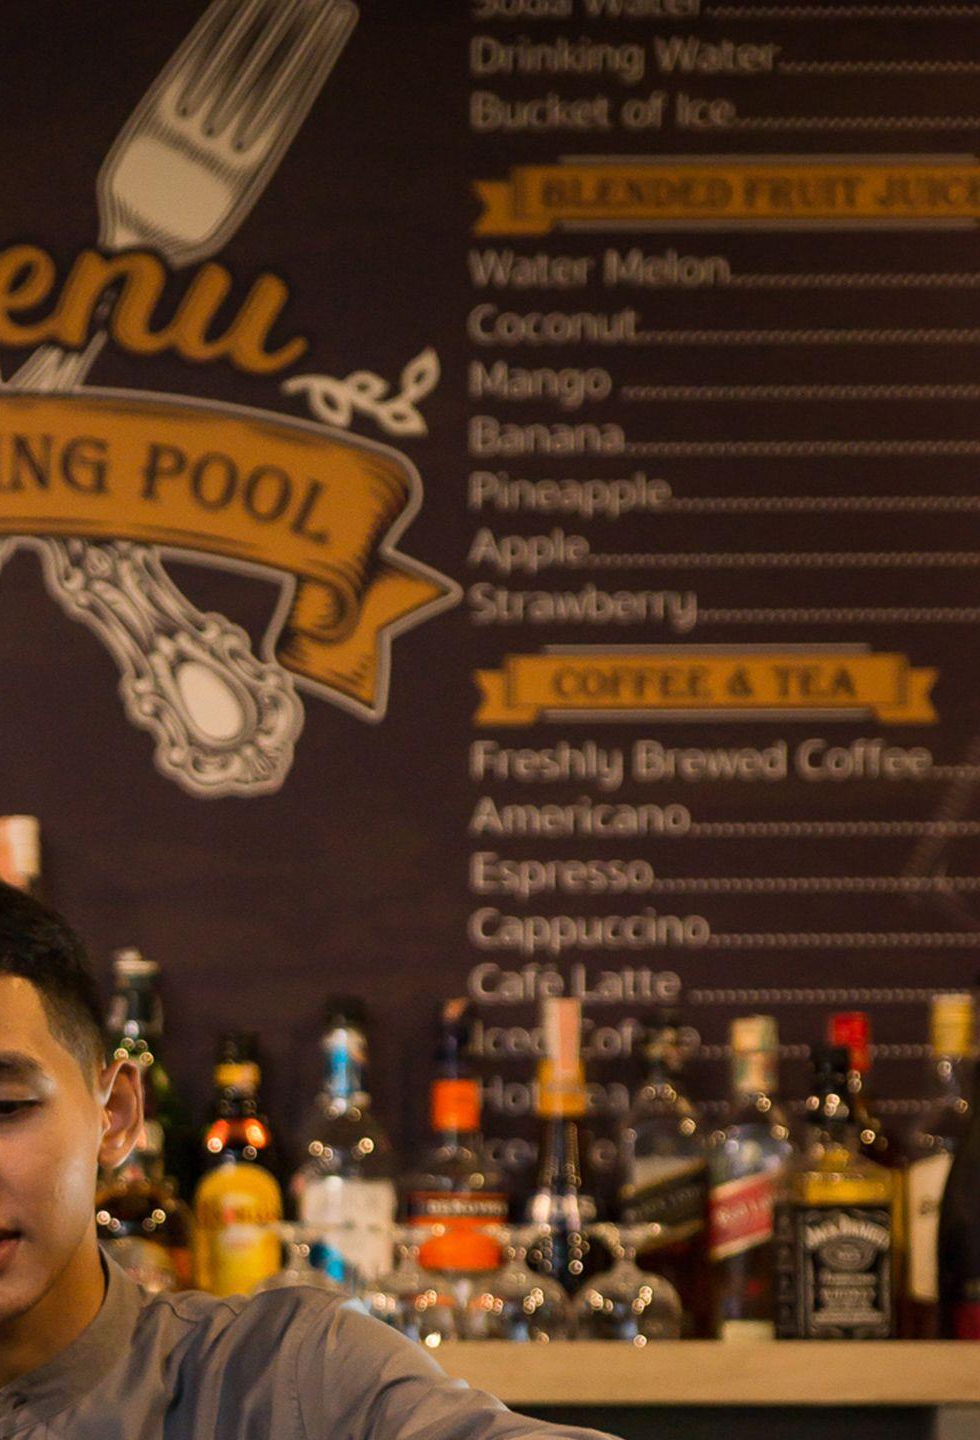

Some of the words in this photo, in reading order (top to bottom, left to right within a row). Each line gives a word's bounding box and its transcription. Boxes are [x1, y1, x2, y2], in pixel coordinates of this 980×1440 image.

[469, 36, 647, 86] Drinking
[654, 36, 781, 75] Water
[469, 89, 611, 131] Bucket
[621, 89, 668, 131] of
[675, 91, 737, 131] Ice
[467, 248, 592, 290] Water
[603, 248, 732, 290] Melon
[466, 303, 640, 345] Coconut
[469, 359, 613, 411] Mango
[469, 414, 625, 458] Banana
[139, 440, 337, 548] POOL
[468, 470, 672, 519] Pineapple
[466, 526, 591, 575] Apple
[468, 582, 698, 634] Strawberry
[551, 664, 712, 700] COFFEE
[724, 664, 754, 700] &
[772, 664, 859, 700] TEA
[469, 739, 624, 790] Freshly
[632, 738, 788, 782] Brewed
[795, 738, 933, 781] Coffee
[467, 795, 692, 839] Americano
[469, 851, 655, 900] Espresso
[466, 906, 711, 956] Cappuccino
[570, 961, 682, 1004] Latte
